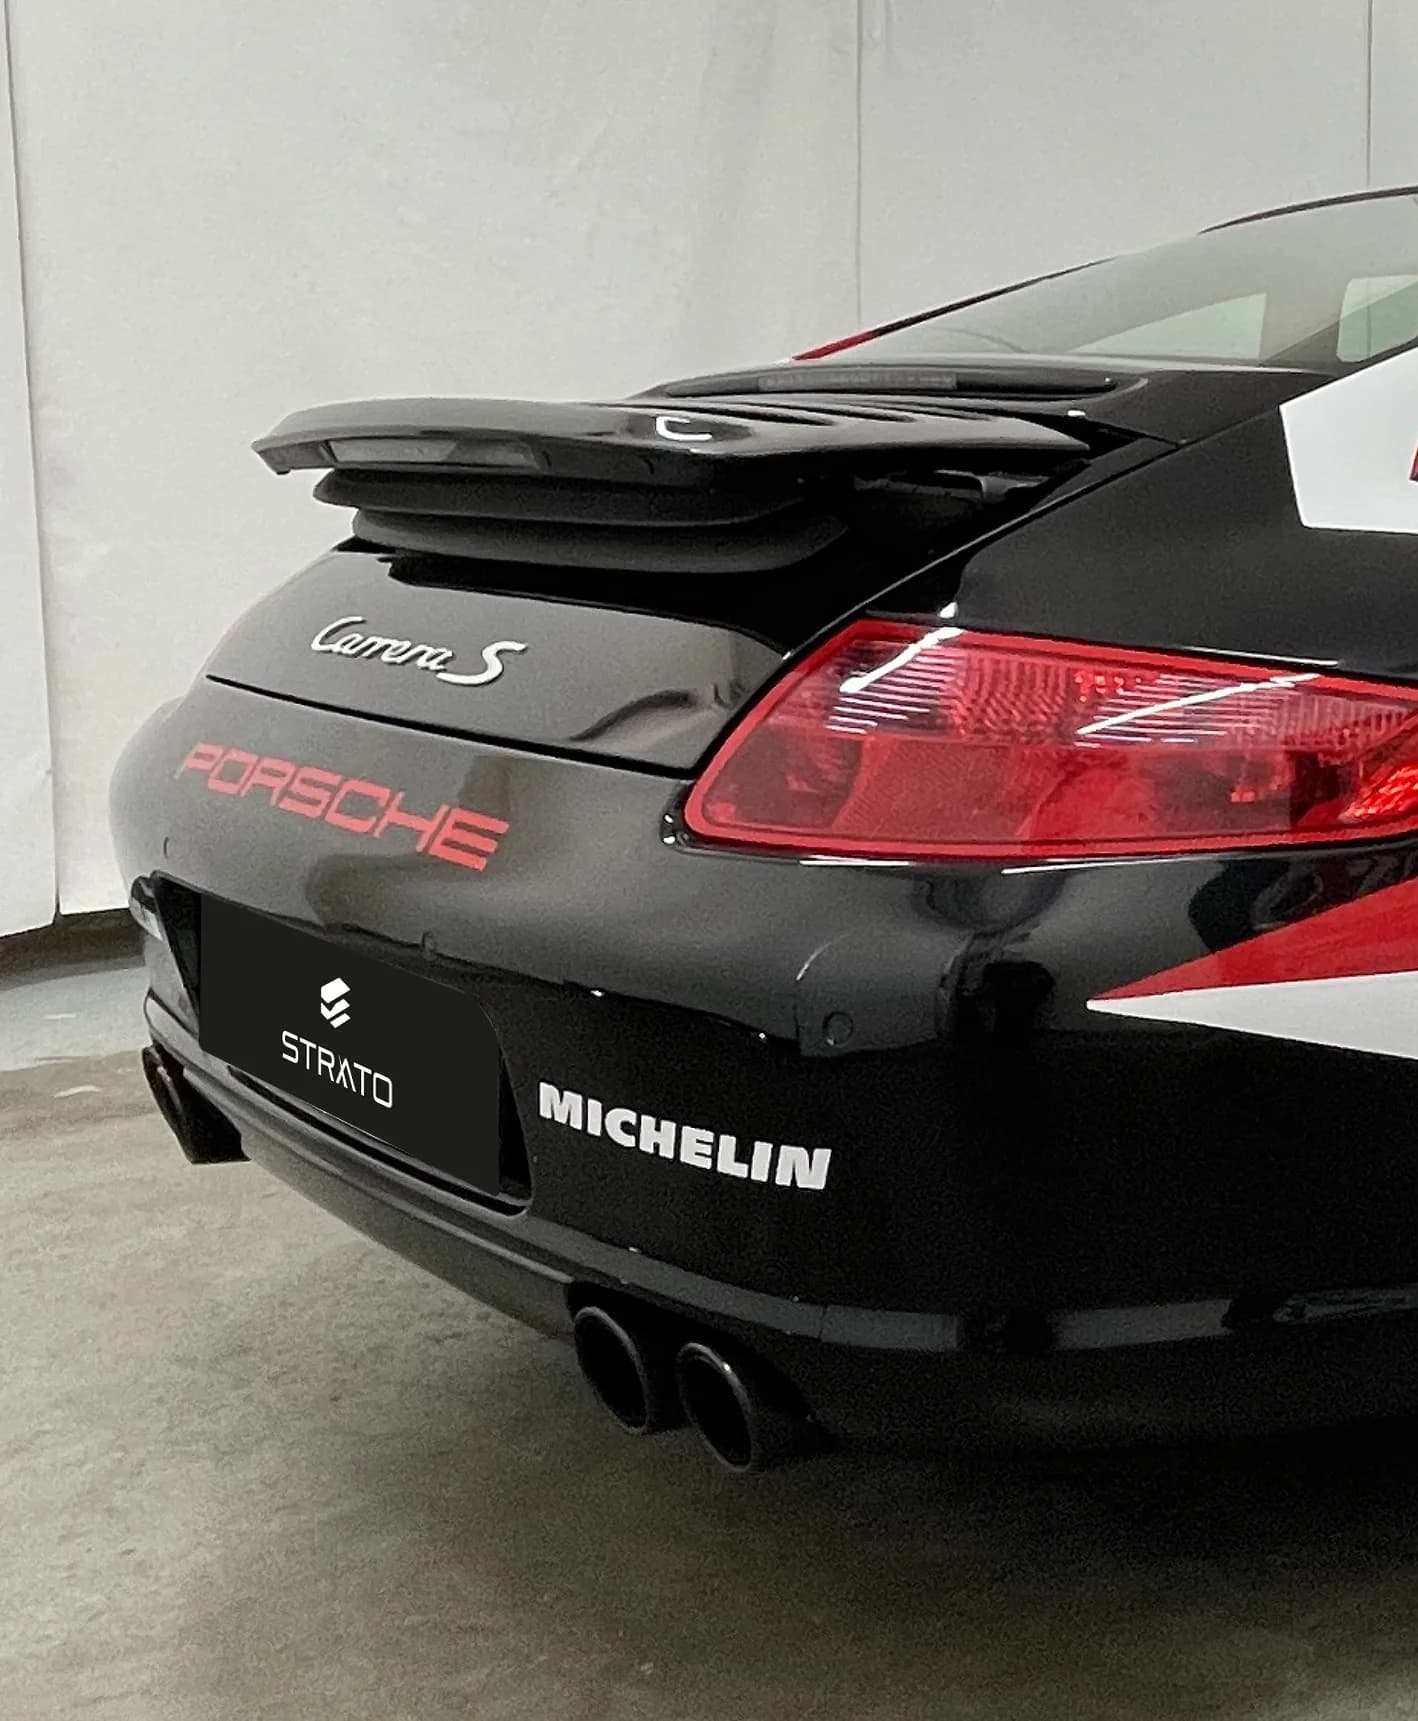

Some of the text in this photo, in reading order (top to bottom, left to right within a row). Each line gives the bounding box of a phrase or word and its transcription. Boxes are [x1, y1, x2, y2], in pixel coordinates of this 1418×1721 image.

[311, 616, 528, 685] Carrera S
[174, 742, 509, 872] PORSCHE
[539, 1082, 832, 1190] MICHELIN
